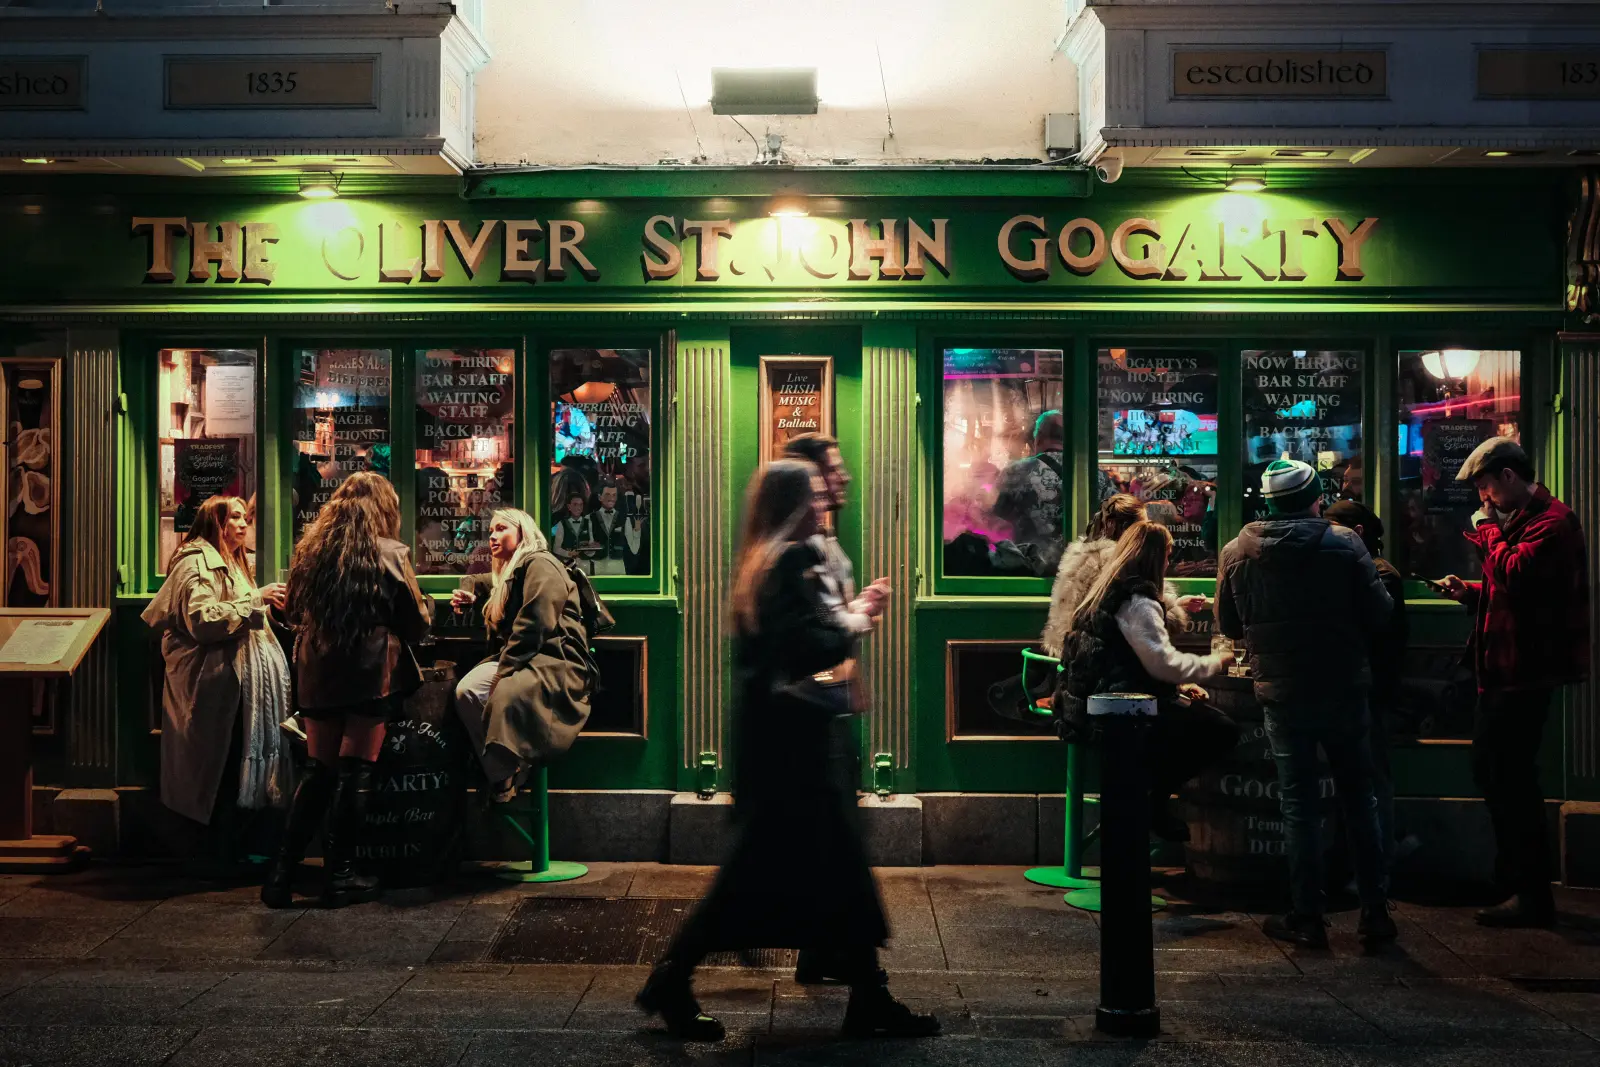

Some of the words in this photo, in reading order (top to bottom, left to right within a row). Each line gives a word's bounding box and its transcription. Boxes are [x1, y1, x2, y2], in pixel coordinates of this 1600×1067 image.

[1186, 58, 1374, 84] established
[245, 71, 297, 95] 1835
[131, 216, 280, 285] THE
[998, 214, 1379, 282] GOGARTY
[460, 356, 511, 368] HIRING
[1119, 358, 1197, 369] OGARTY'S
[1247, 356, 1288, 370] NOW
[1294, 357, 1357, 370] HIRING
[420, 374, 454, 387] BAR
[458, 373, 508, 386] STAFF
[787, 372, 808, 383] Live
[1127, 371, 1185, 383] HOSTEL
[1258, 375, 1292, 388] BAR
[1297, 375, 1348, 388] STAFF
[780, 384, 815, 394] IRISH
[427, 392, 501, 404] WAITING
[778, 396, 816, 406] MUSIC
[1110, 391, 1146, 404] NOW
[1151, 391, 1205, 404] HIRING
[1264, 393, 1341, 407] WAITING
[438, 405, 489, 418] STAFF
[792, 406, 802, 417] &
[778, 418, 817, 429] Ballads
[424, 424, 470, 437] BACK
[1260, 426, 1305, 439] BACK
[1284, 441, 1328, 454] TAFF
[192, 475, 223, 483] Gogarty's
[297, 510, 319, 520] App
[1167, 523, 1189, 533] mail
[1191, 524, 1202, 533] to
[420, 538, 451, 550] Apply
[417, 721, 448, 750] John
[404, 807, 436, 824] Bar
